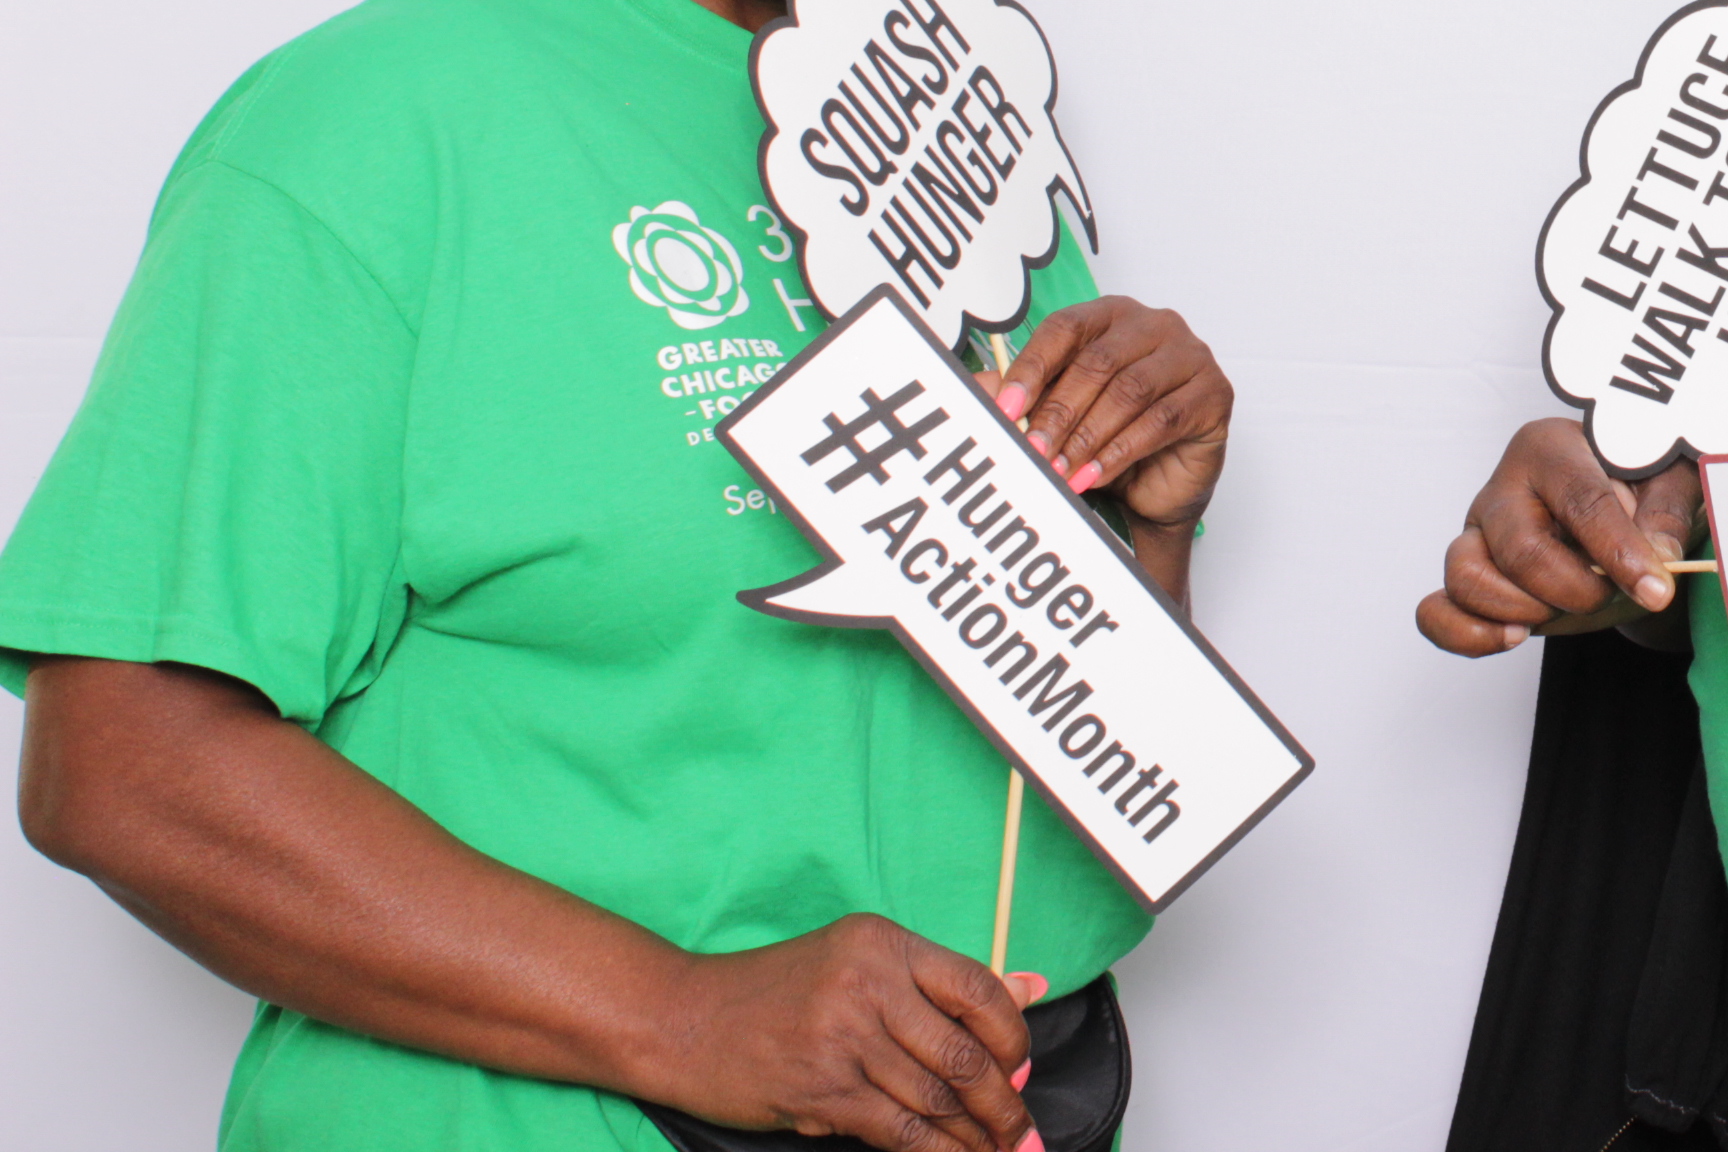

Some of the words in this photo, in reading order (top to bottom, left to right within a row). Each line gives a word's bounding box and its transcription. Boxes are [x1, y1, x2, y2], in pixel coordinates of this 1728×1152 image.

[868, 66, 1032, 309] HUNGER
[656, 338, 784, 371] GREATER
[660, 362, 788, 398] CHICAG
[863, 498, 1180, 843] ActionMonth
